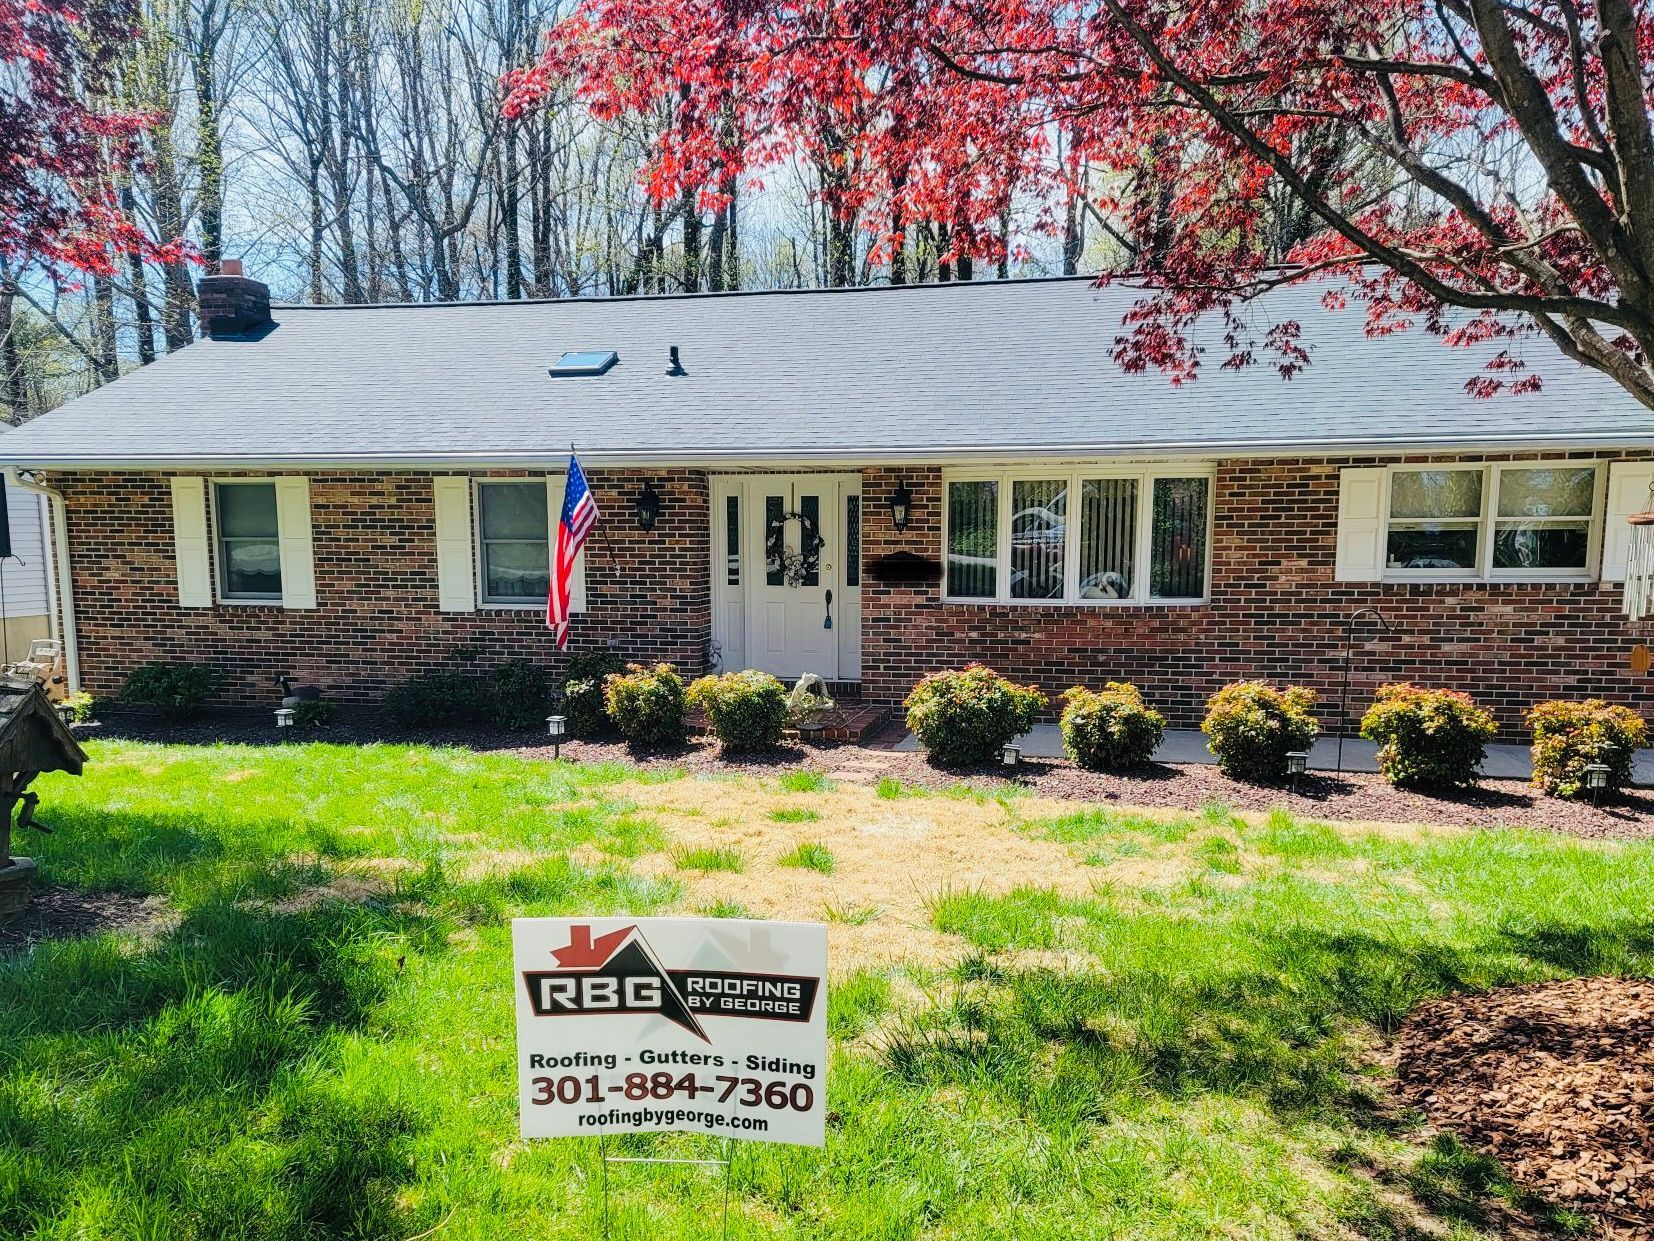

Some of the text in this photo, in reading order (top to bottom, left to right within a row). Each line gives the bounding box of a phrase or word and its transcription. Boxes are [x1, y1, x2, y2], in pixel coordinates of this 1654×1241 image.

[540, 976, 662, 1010] RBG
[687, 977, 801, 999] ROOFING
[687, 996, 801, 1014] BY GEORGE
[530, 1052, 617, 1069] Roofing
[639, 1050, 724, 1067] Gutters
[746, 1055, 816, 1079] Siding
[531, 1072, 814, 1112] 301-884-7360
[578, 1108, 769, 1131] roofingbygeorge.com
